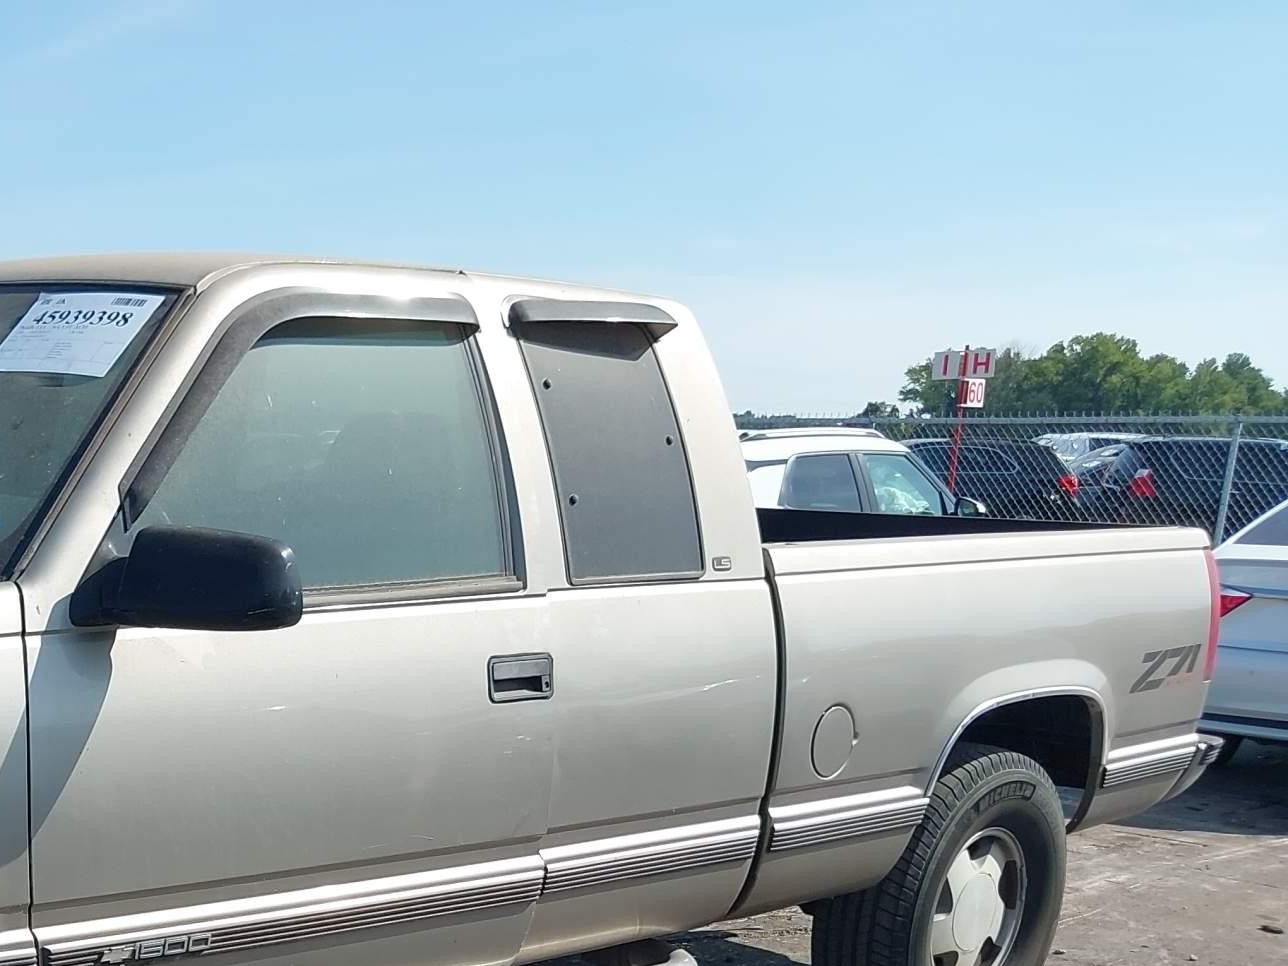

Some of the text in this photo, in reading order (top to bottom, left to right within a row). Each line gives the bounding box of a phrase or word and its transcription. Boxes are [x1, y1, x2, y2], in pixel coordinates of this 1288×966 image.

[32, 309, 135, 328] 45939398
[972, 352, 991, 375] H
[968, 381, 984, 403] 60
[1128, 643, 1203, 694] Z71
[135, 932, 212, 960] 1500
